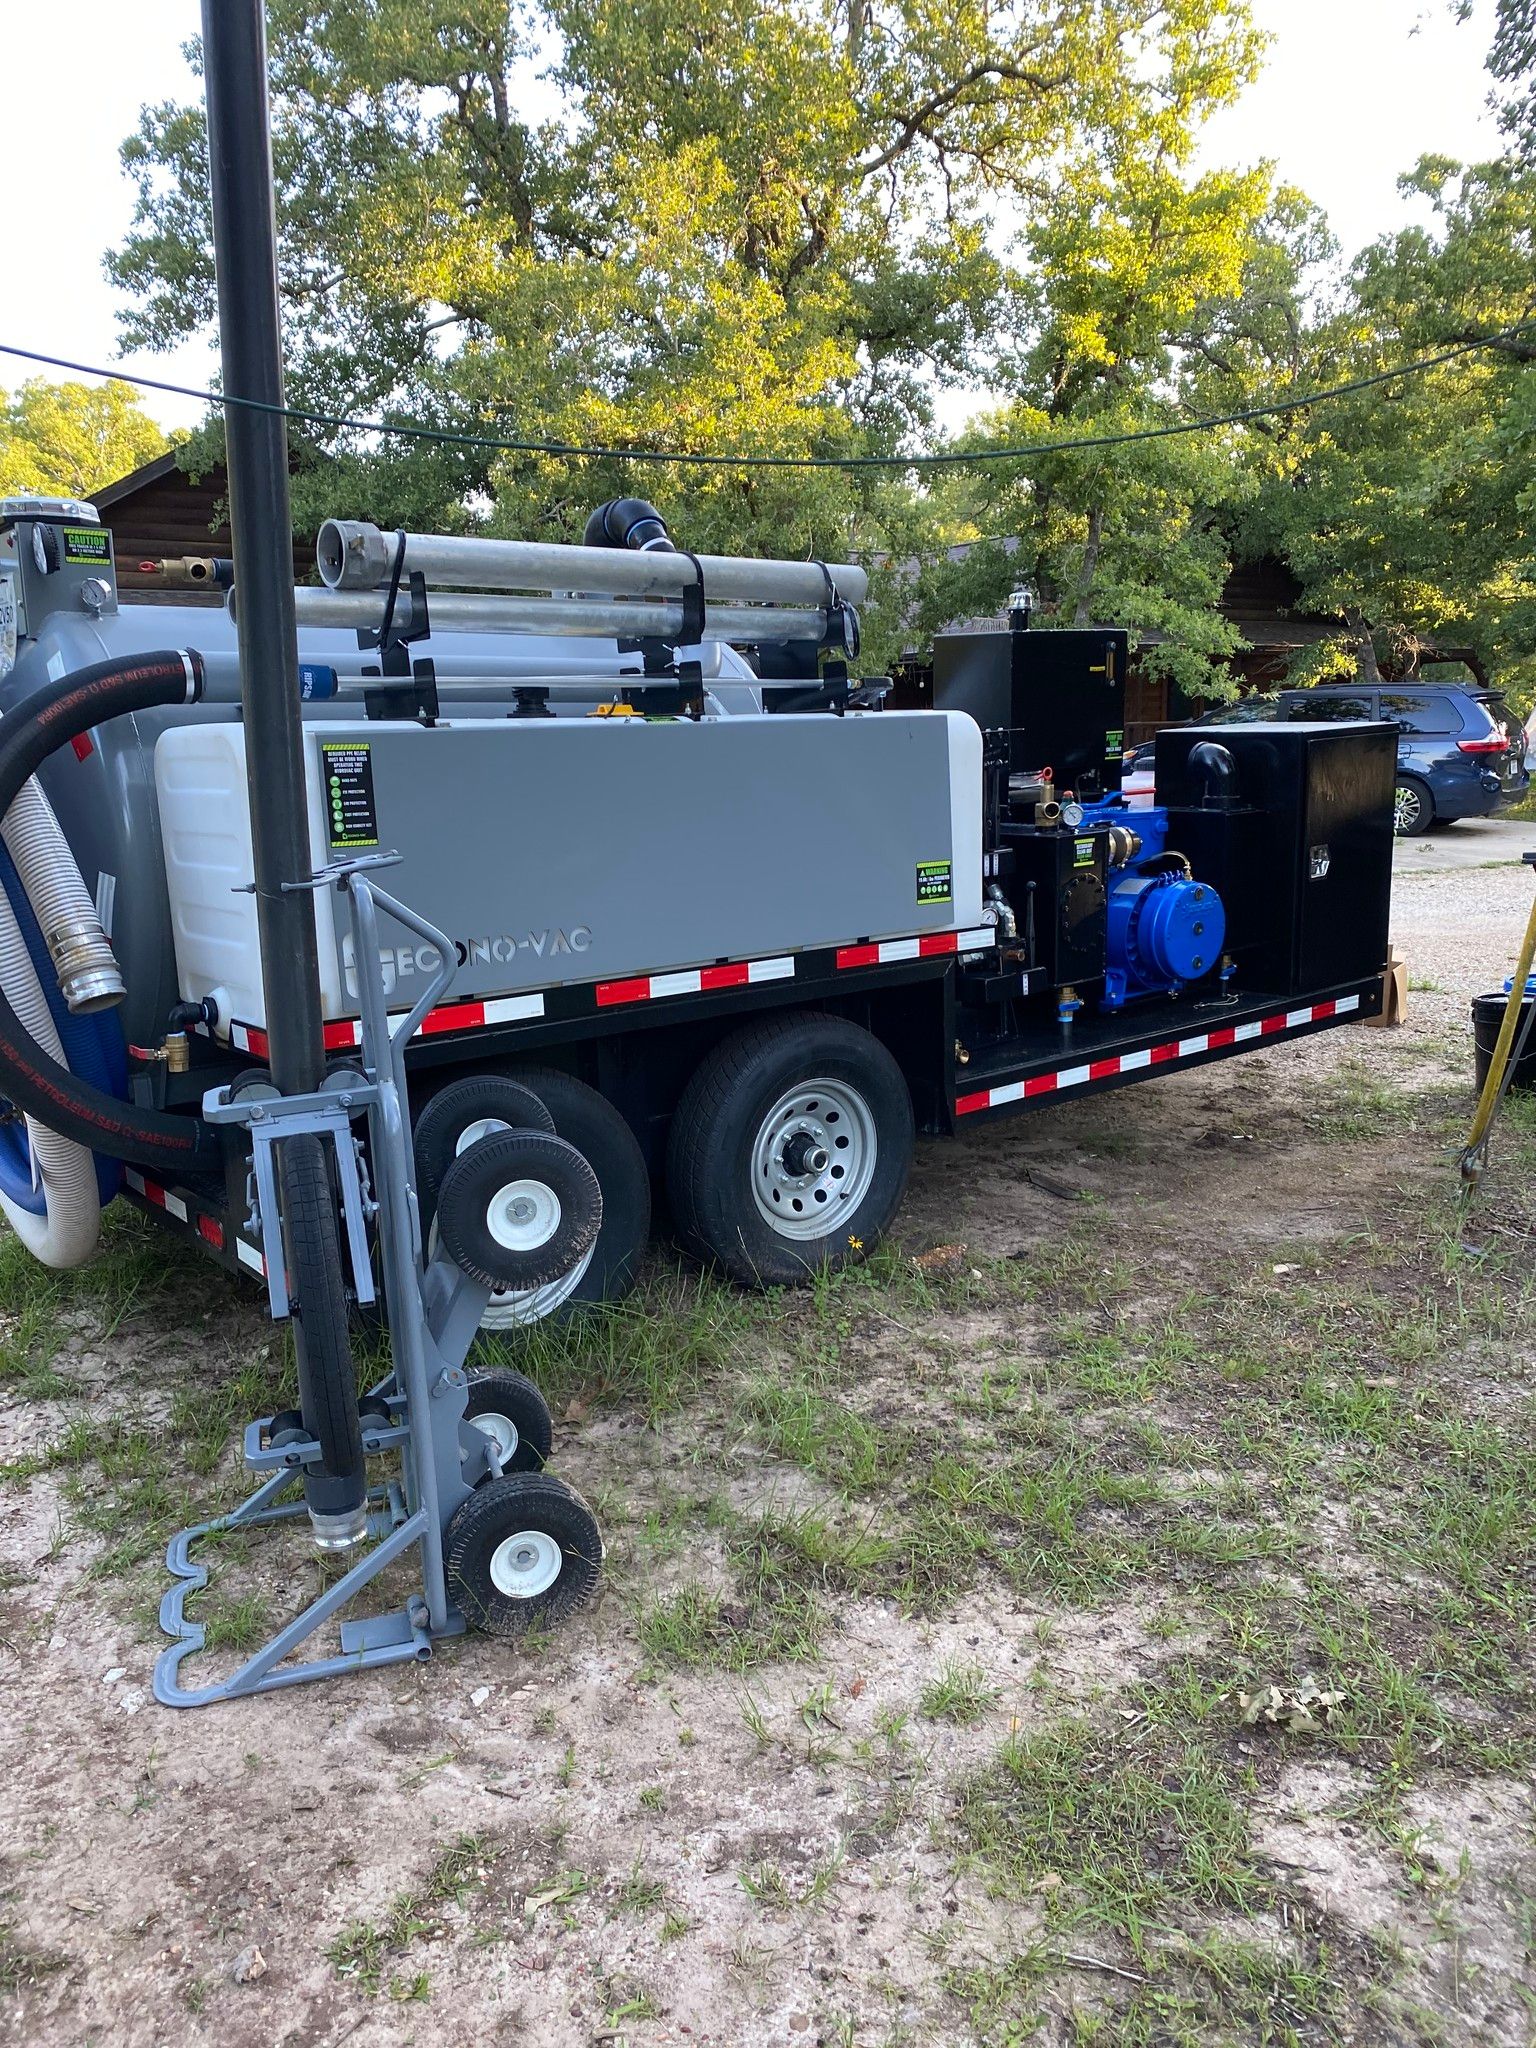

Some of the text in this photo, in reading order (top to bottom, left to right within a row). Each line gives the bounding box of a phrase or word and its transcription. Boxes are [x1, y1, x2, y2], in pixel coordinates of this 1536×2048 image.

[68, 535, 105, 546] CAUTION
[124, 664, 184, 681] ETROLEUM
[32, 1073, 96, 1121] PETROLEUM
